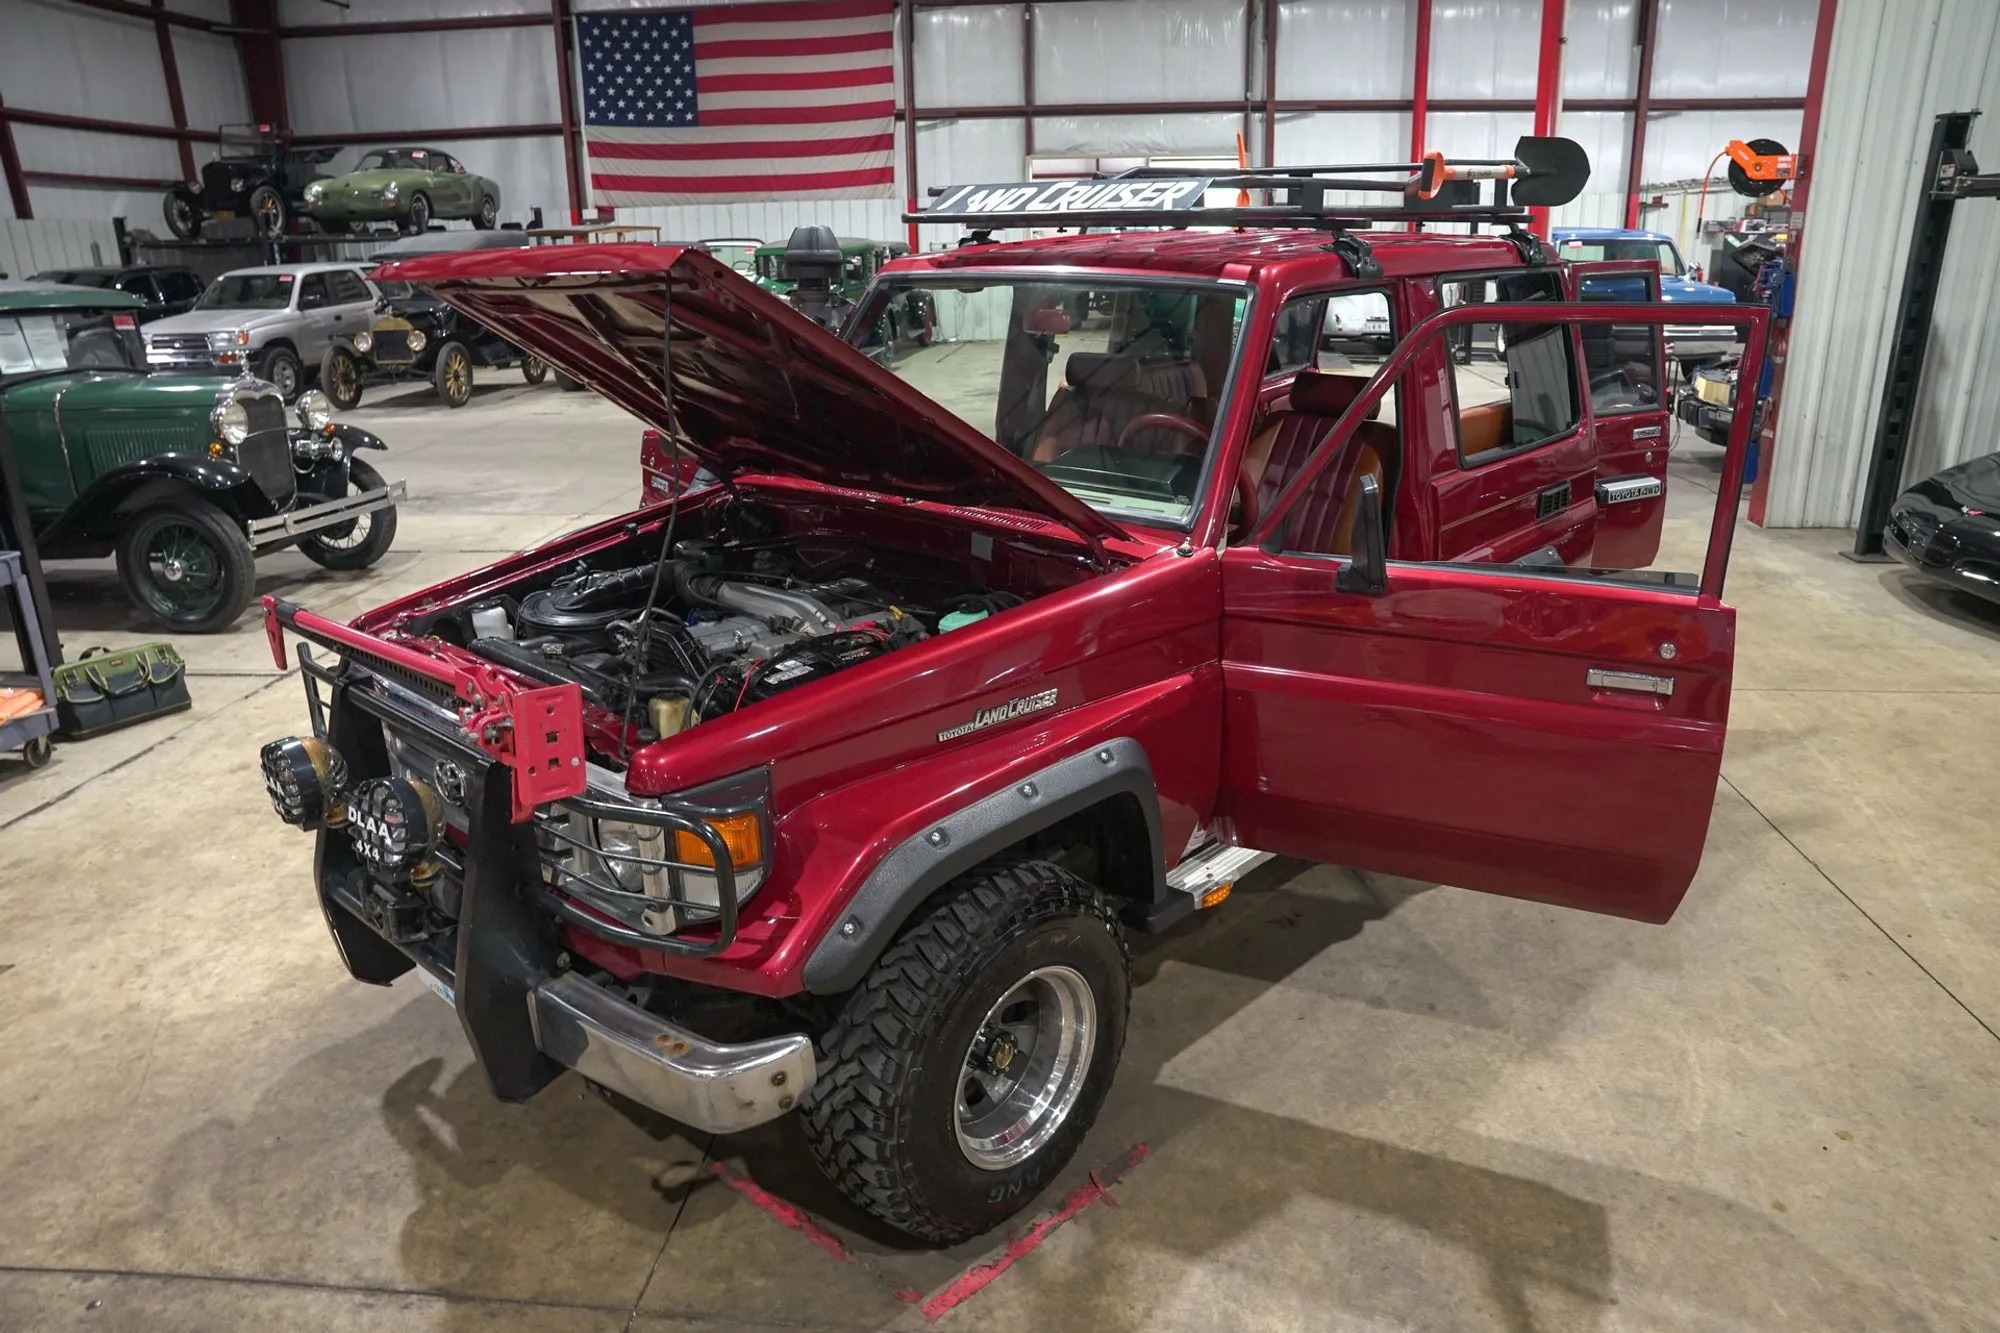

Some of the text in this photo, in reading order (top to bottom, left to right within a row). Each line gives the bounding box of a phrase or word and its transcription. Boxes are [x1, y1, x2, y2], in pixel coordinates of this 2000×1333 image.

[1024, 181, 1199, 211] CRUISER
[1610, 488, 1641, 502] TOYOTA
[939, 688, 1058, 742] TOYOTA LAND CRUISER
[348, 805, 392, 847] DLAA
[357, 839, 380, 861] 4X4
